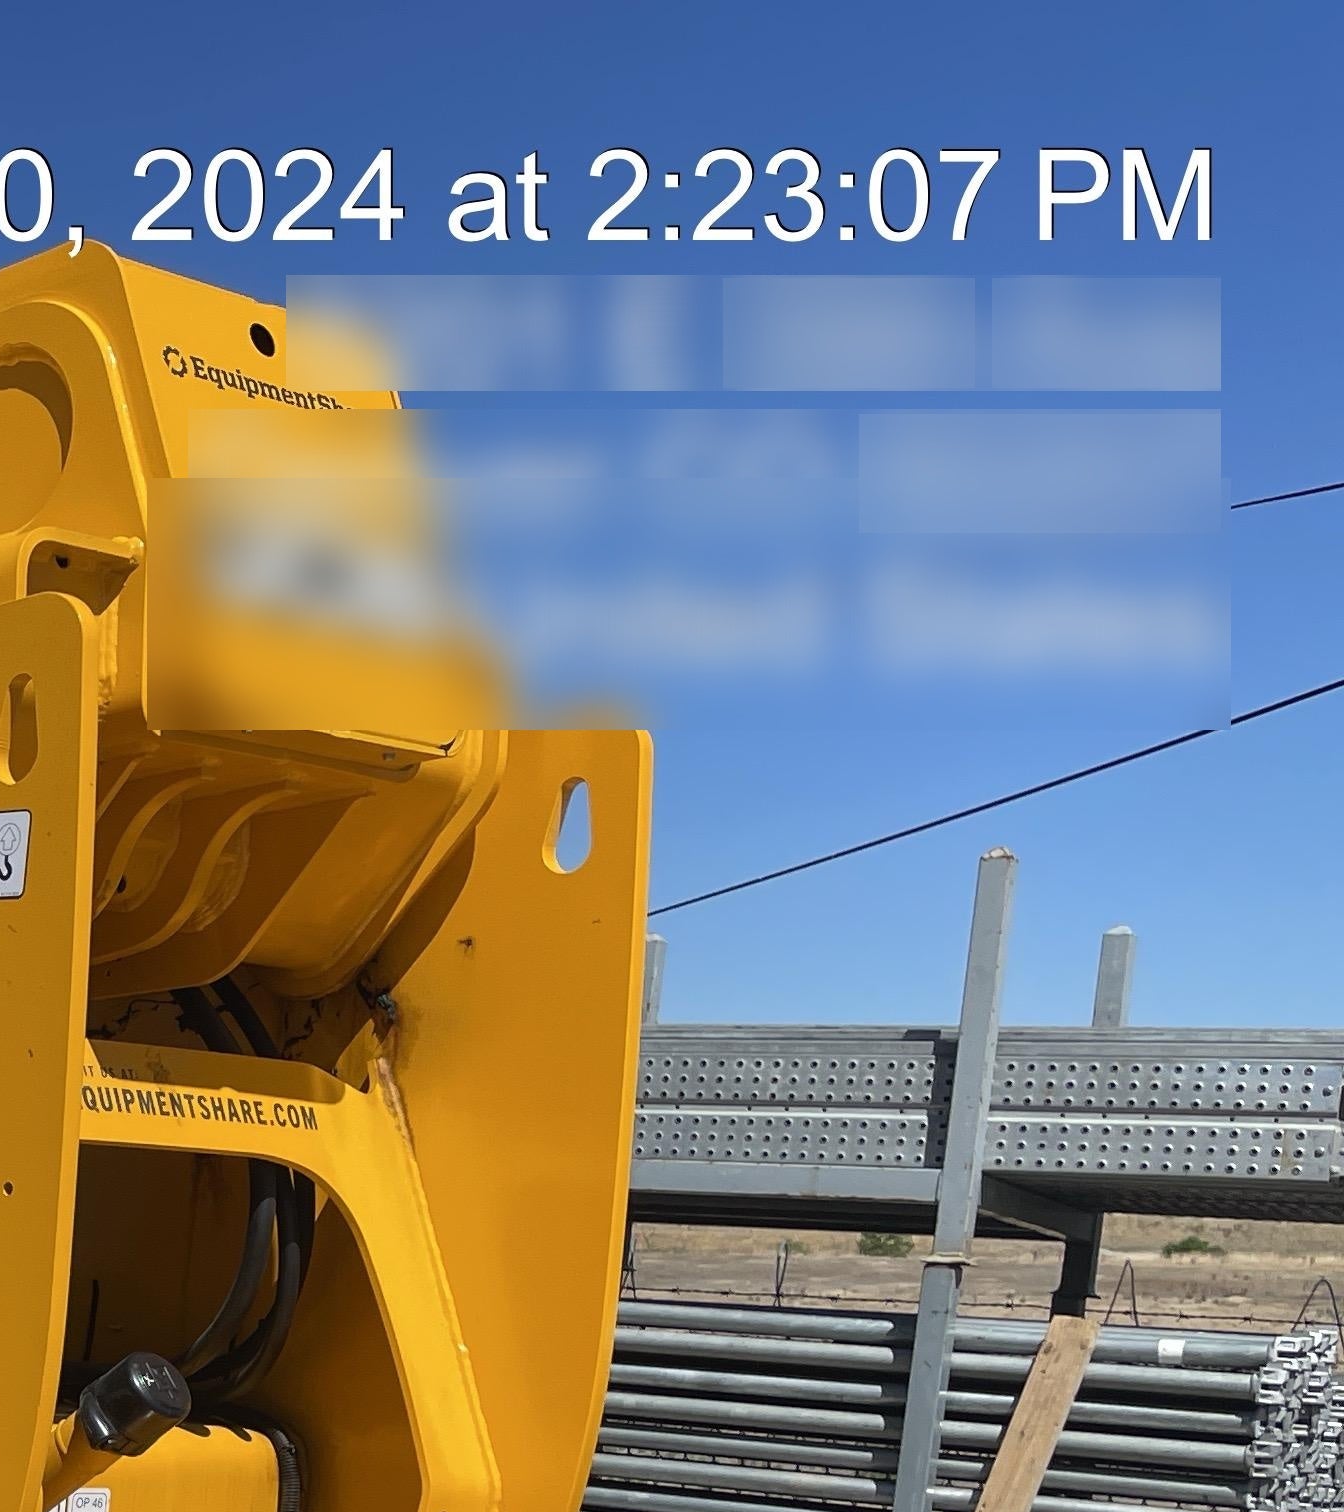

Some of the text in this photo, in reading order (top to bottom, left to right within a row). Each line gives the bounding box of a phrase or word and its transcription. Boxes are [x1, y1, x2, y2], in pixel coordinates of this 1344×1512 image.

[189, 355, 354, 410] EquipmentSh
[80, 1085, 318, 1131] QUIPMENTSHARE.COM
[75, 1496, 90, 1509] OP
